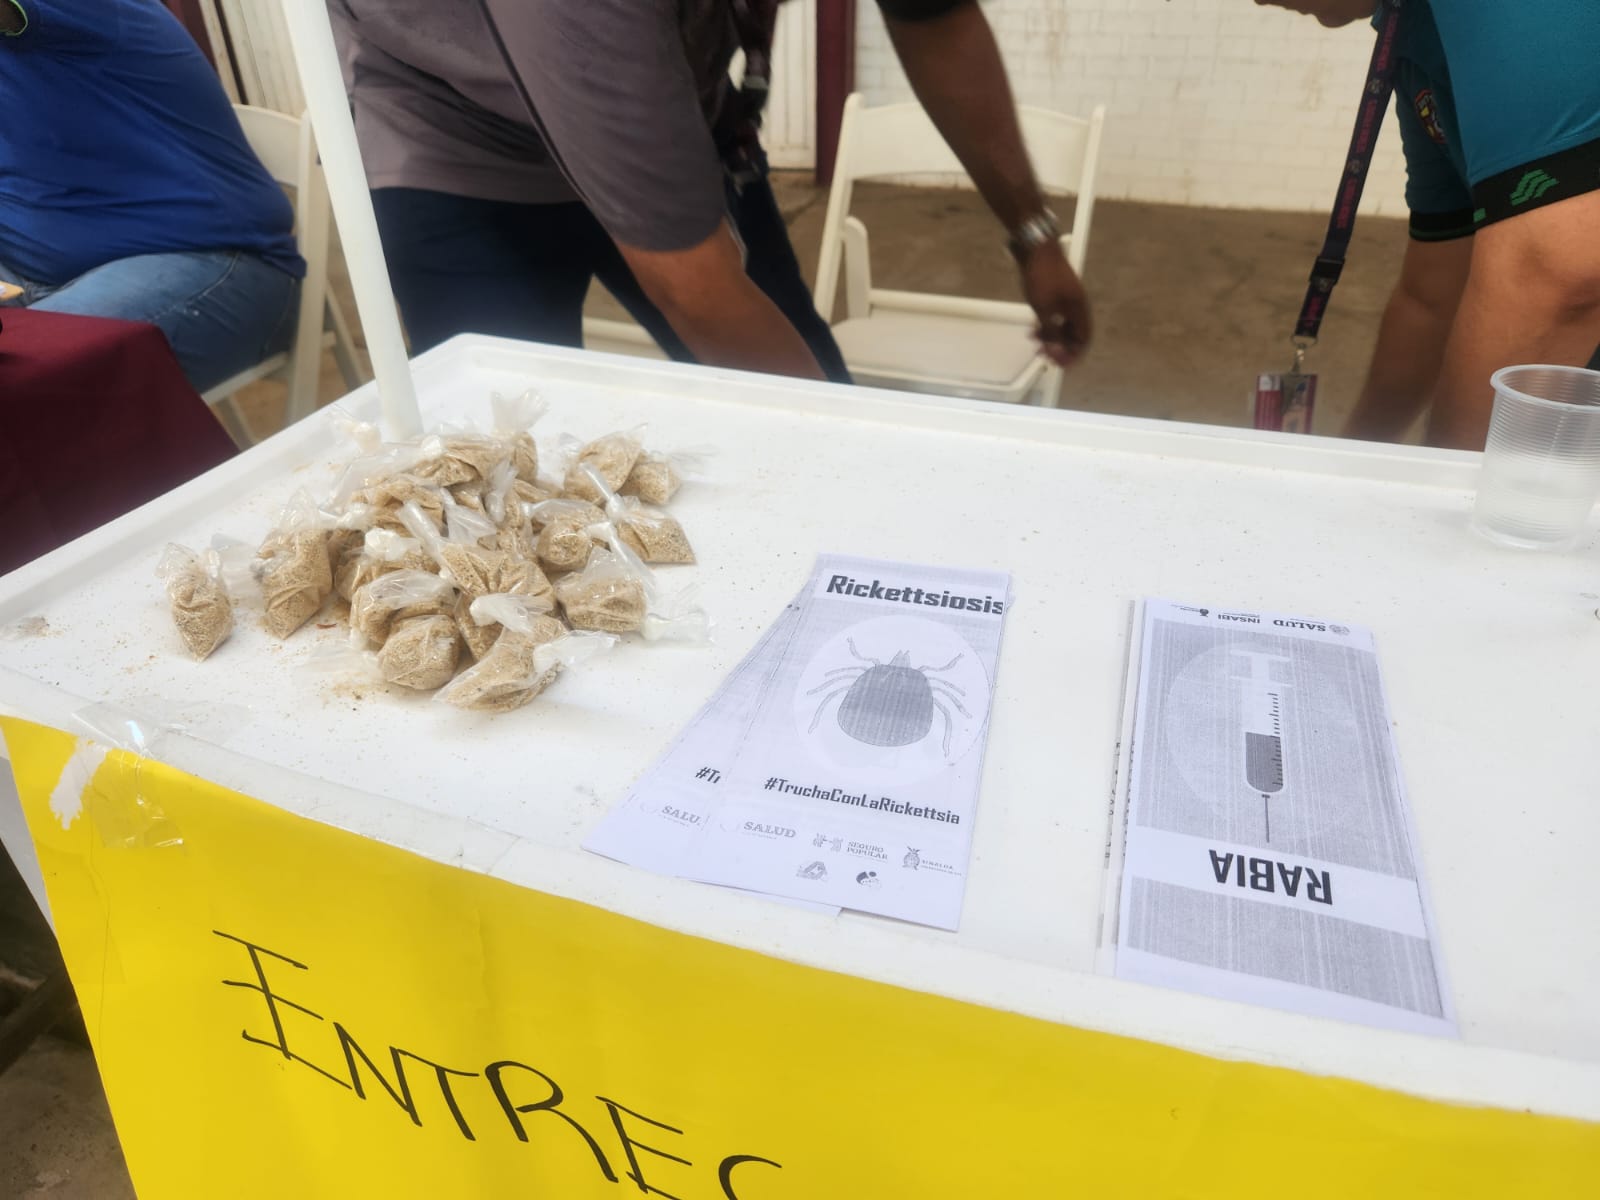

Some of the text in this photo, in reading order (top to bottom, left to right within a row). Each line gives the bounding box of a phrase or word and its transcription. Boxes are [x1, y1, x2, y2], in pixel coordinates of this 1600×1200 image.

[826, 574, 1004, 615] Rickettsiosis
[1217, 614, 1260, 624] INSABI
[1273, 619, 1326, 632] SALUD
[764, 777, 960, 825] #TruchaConLaRickettsia
[661, 805, 701, 826] SALU
[743, 821, 796, 839] SALUD
[846, 847, 888, 860] POPULAR
[847, 841, 884, 853] SEGURO
[1208, 849, 1333, 905] RABIA
